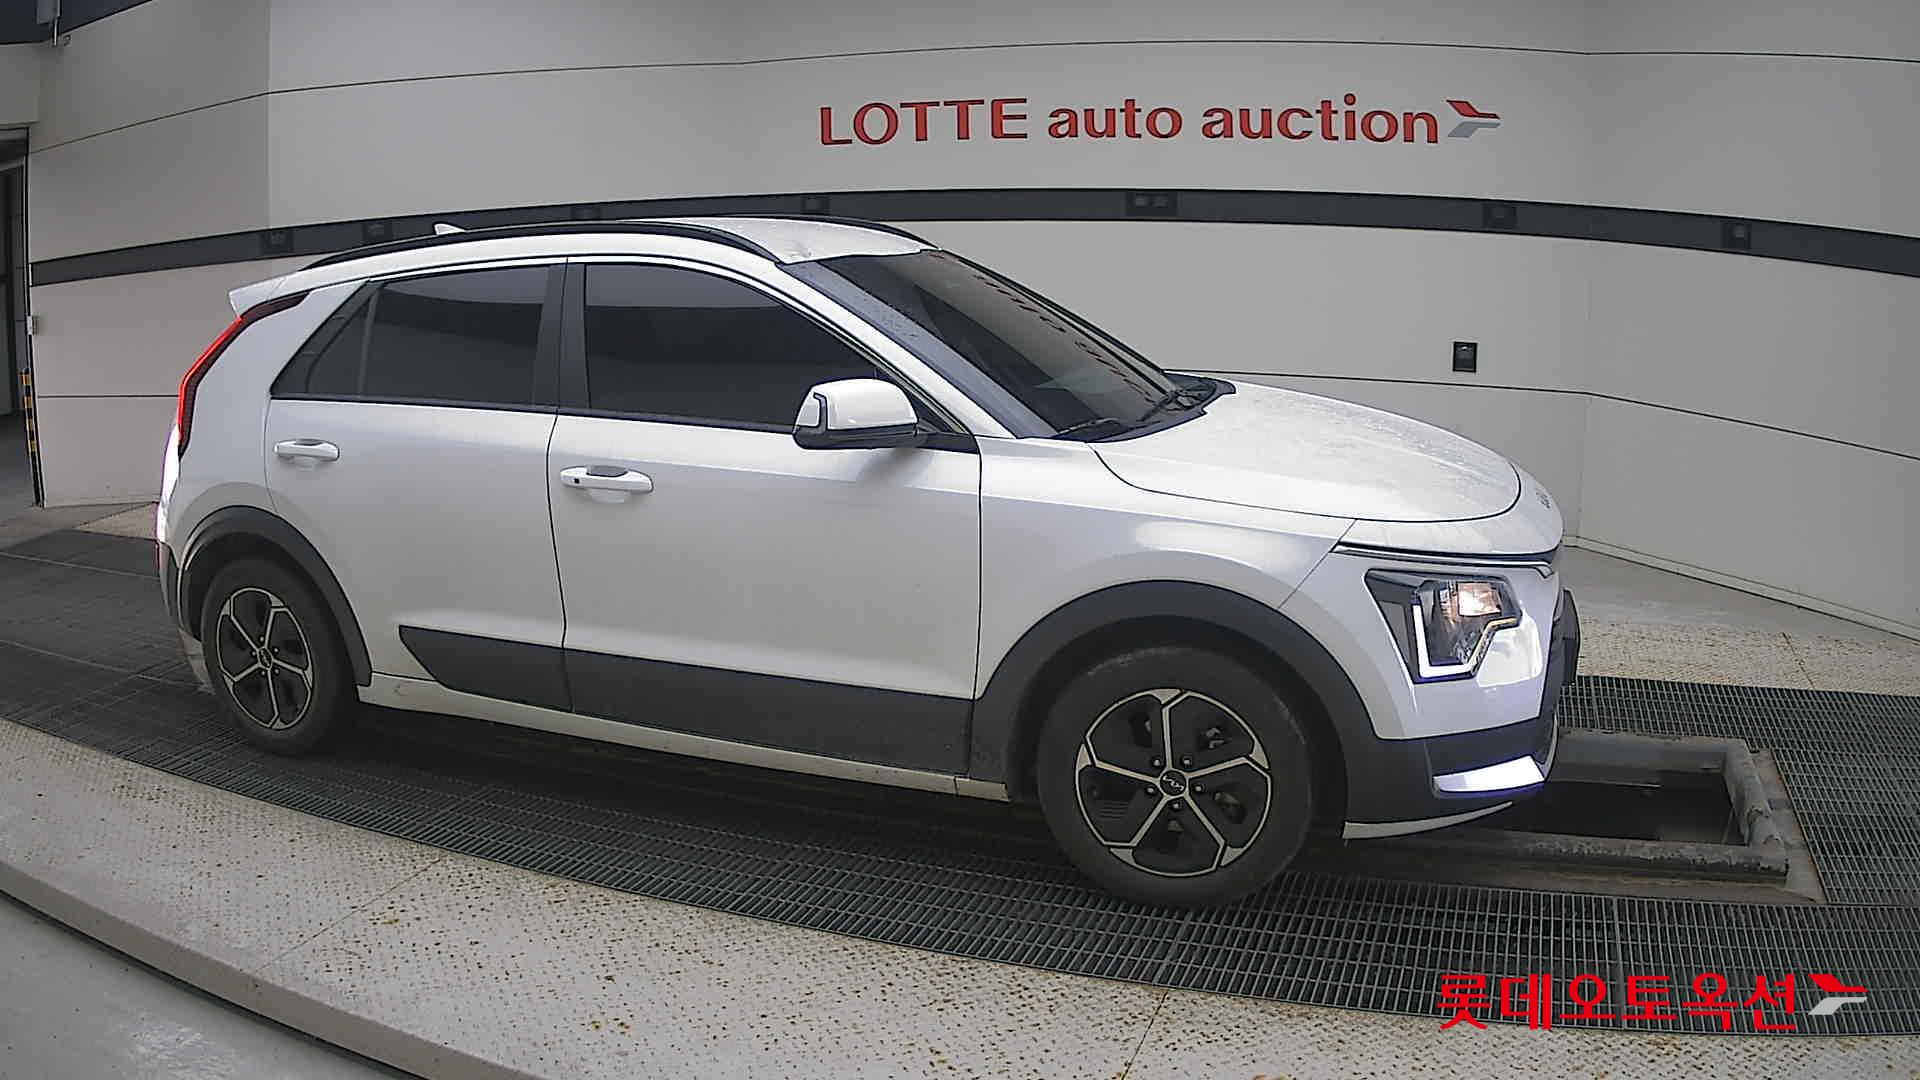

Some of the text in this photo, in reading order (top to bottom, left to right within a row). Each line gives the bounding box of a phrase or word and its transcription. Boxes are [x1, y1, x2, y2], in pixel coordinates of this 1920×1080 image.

[820, 93, 1440, 146] LOTTE auto auction
